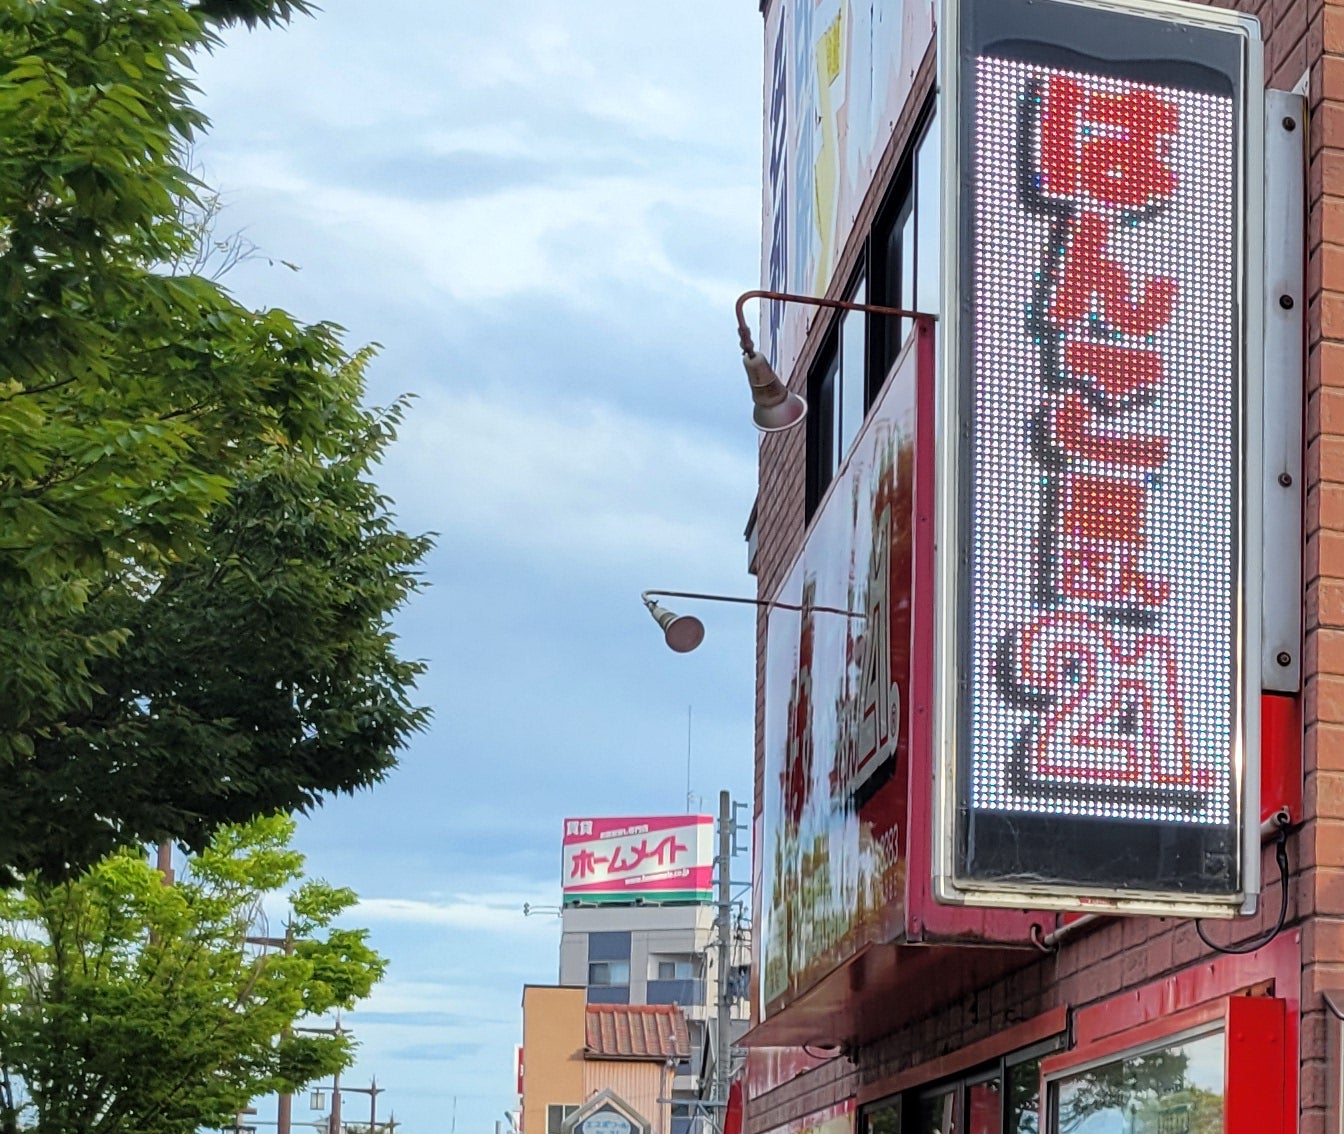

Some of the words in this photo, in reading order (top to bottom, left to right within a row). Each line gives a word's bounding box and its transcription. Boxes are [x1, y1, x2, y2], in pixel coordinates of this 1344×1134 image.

[571, 835, 689, 878] ホームメイト
